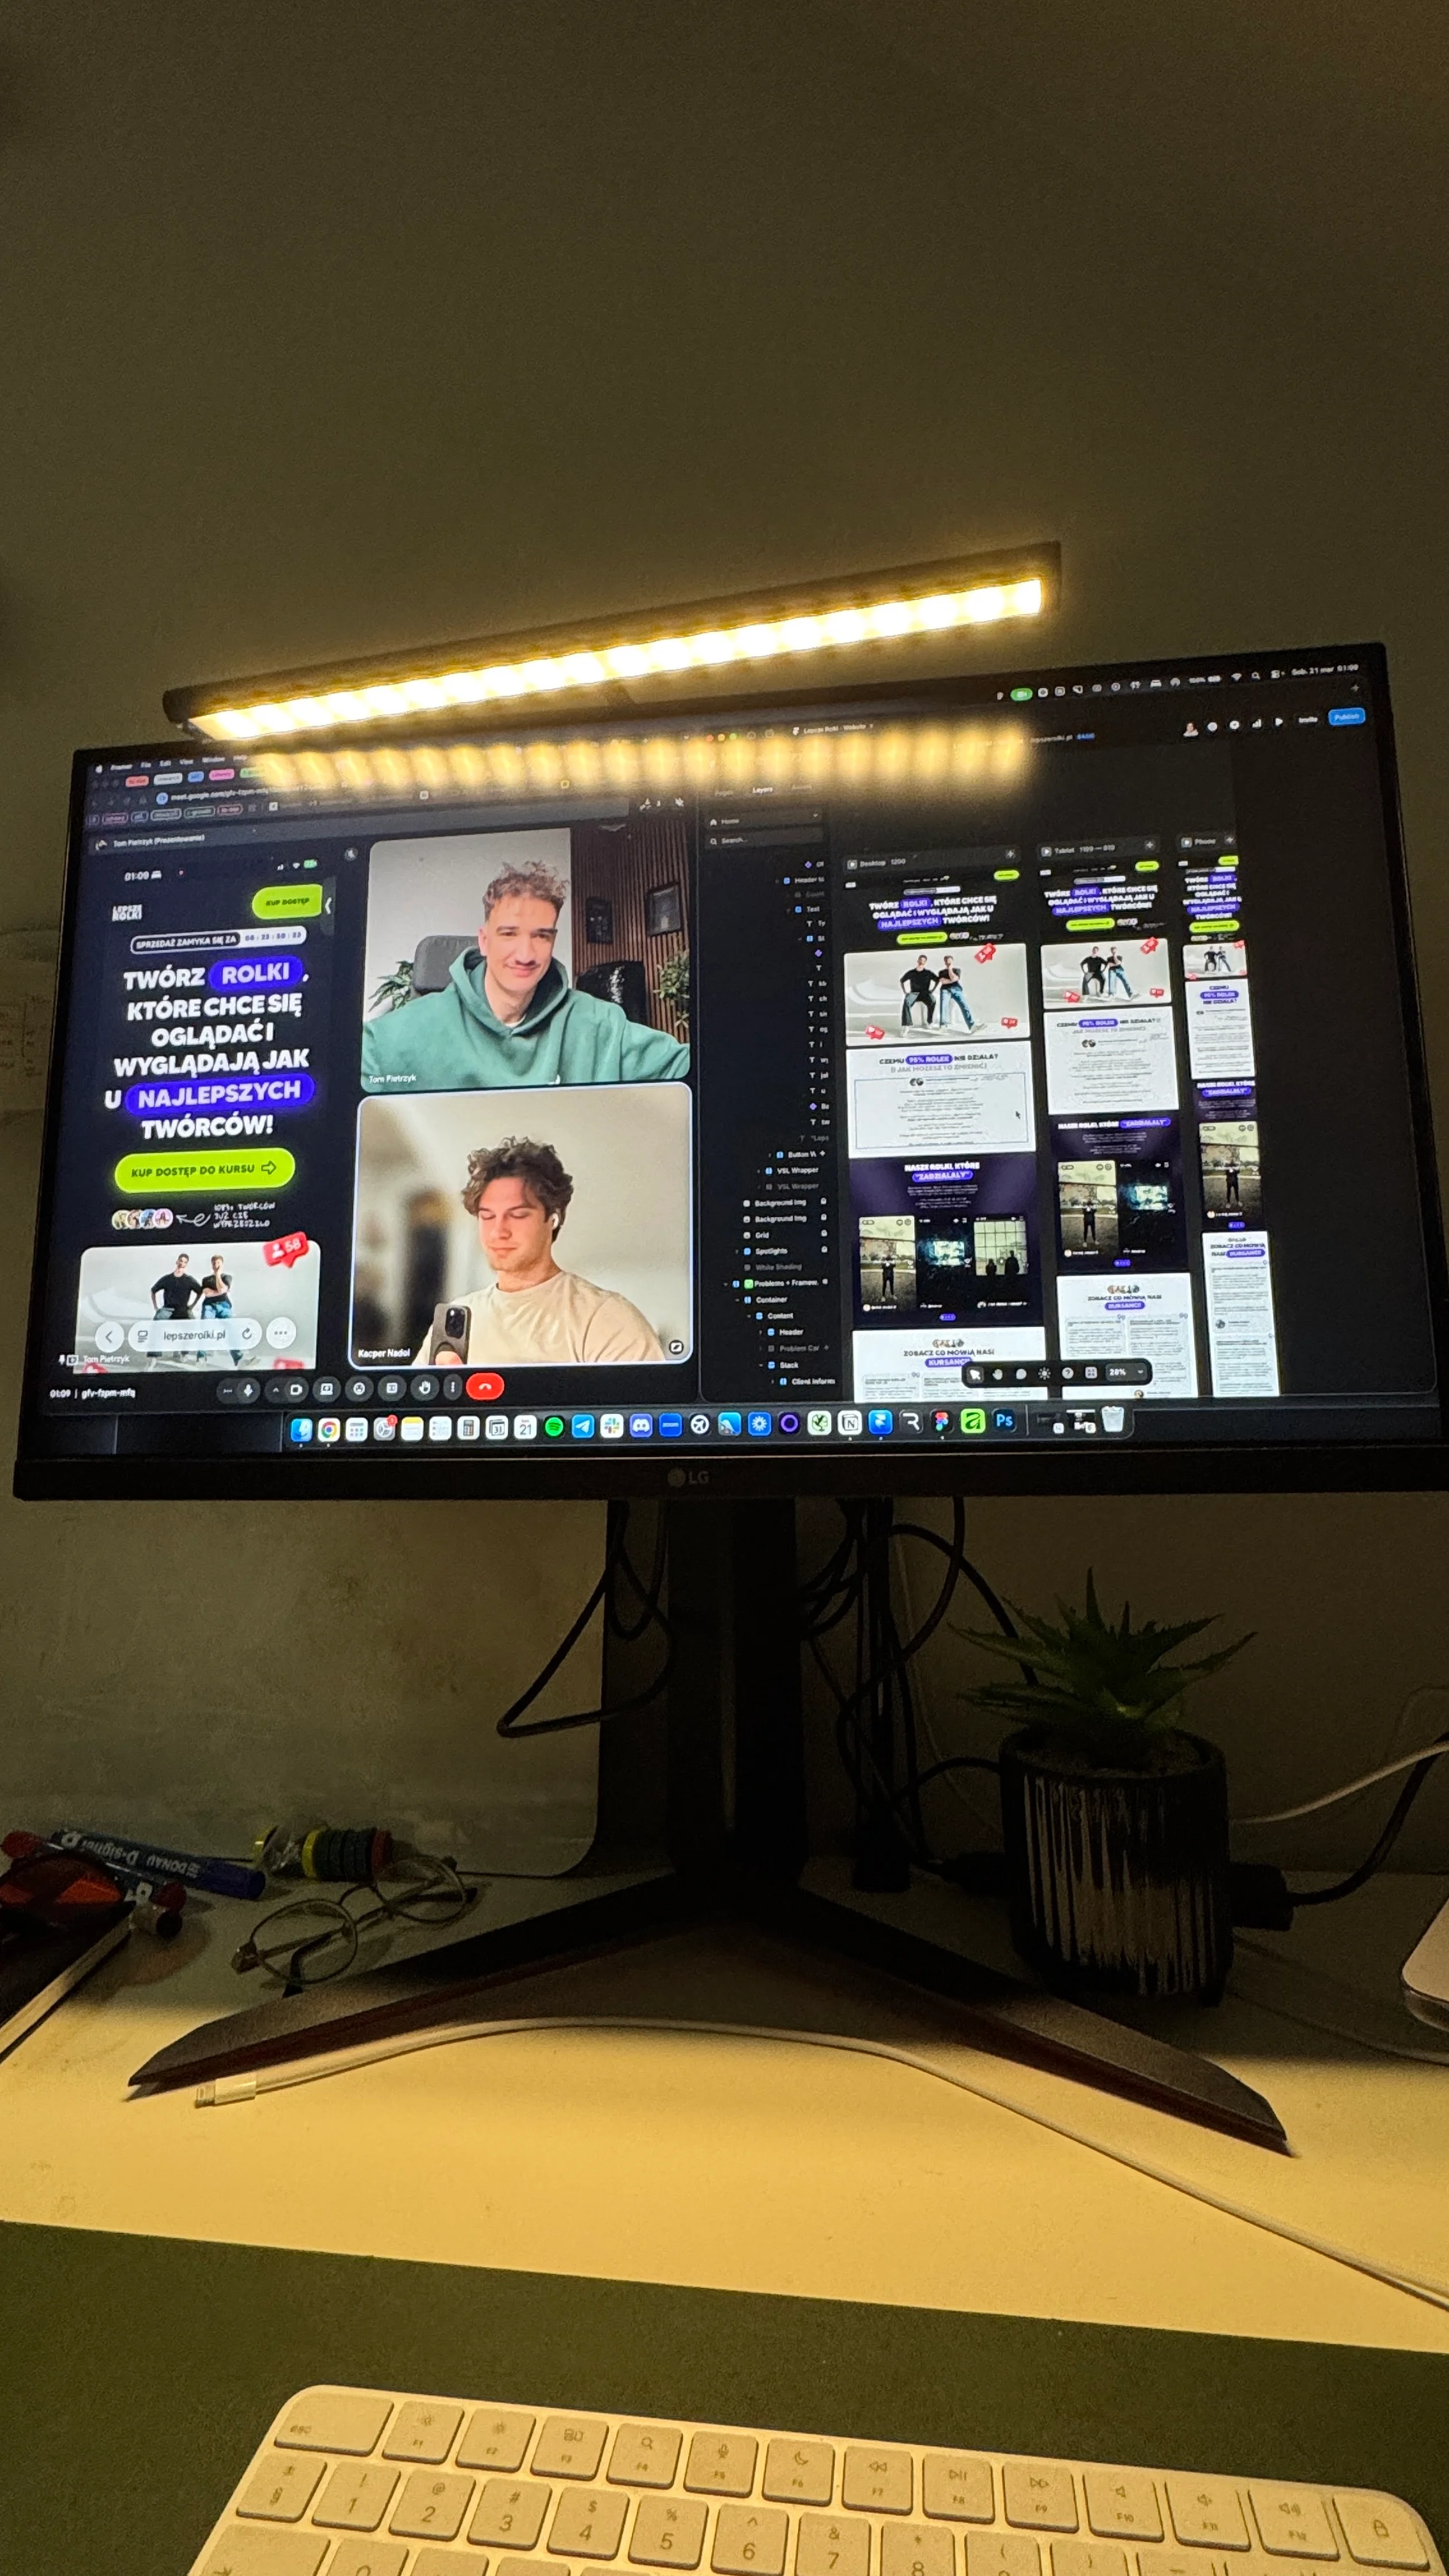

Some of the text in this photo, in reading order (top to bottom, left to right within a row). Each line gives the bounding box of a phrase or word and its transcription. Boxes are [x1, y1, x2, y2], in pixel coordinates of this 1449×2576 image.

[125, 871, 150, 882] 01:09
[176, 935, 211, 947] ZAMYKA
[225, 934, 237, 944] ZA
[123, 962, 290, 990] TWÓRZ ROLKI
[127, 992, 303, 1021] KTÓRE CHCE SIĘ
[150, 1017, 274, 1050] OGLĄDAĆ I
[113, 1048, 310, 1078] WYGLĄDAJĄ JAK
[369, 1075, 385, 1084] Tom
[104, 1080, 302, 1110] U NAJLEPSZYCH
[141, 1110, 274, 1140] TWÓRCÓW!
[131, 1164, 255, 1179] KUP DOSTĘP DO KURSU
[755, 1199, 793, 1208] Background
[755, 1215, 793, 1223] Background
[284, 1238, 302, 1253] 58
[163, 1328, 226, 1341] lepszerolki.pl
[358, 1349, 387, 1360] Kacper
[1108, 1368, 1127, 1377] 28%
[49, 1388, 72, 1399] 01:09
[847, 1416, 856, 1429] N
[996, 1414, 1013, 1427] Ps
[494, 1425, 503, 1434] 31
[519, 1423, 532, 1436] 21
[688, 1470, 710, 1485] LG
[146, 1853, 188, 1874] DONAU
[289, 2424, 312, 2435] esc
[347, 2498, 358, 2514] 1
[420, 2506, 438, 2523] 2
[498, 2514, 514, 2532] 3
[578, 2524, 592, 2542] 4
[659, 2532, 675, 2551] 5
[742, 2542, 756, 2561] 6
[827, 2552, 841, 2570] 7
[911, 2561, 925, 2576] 8
